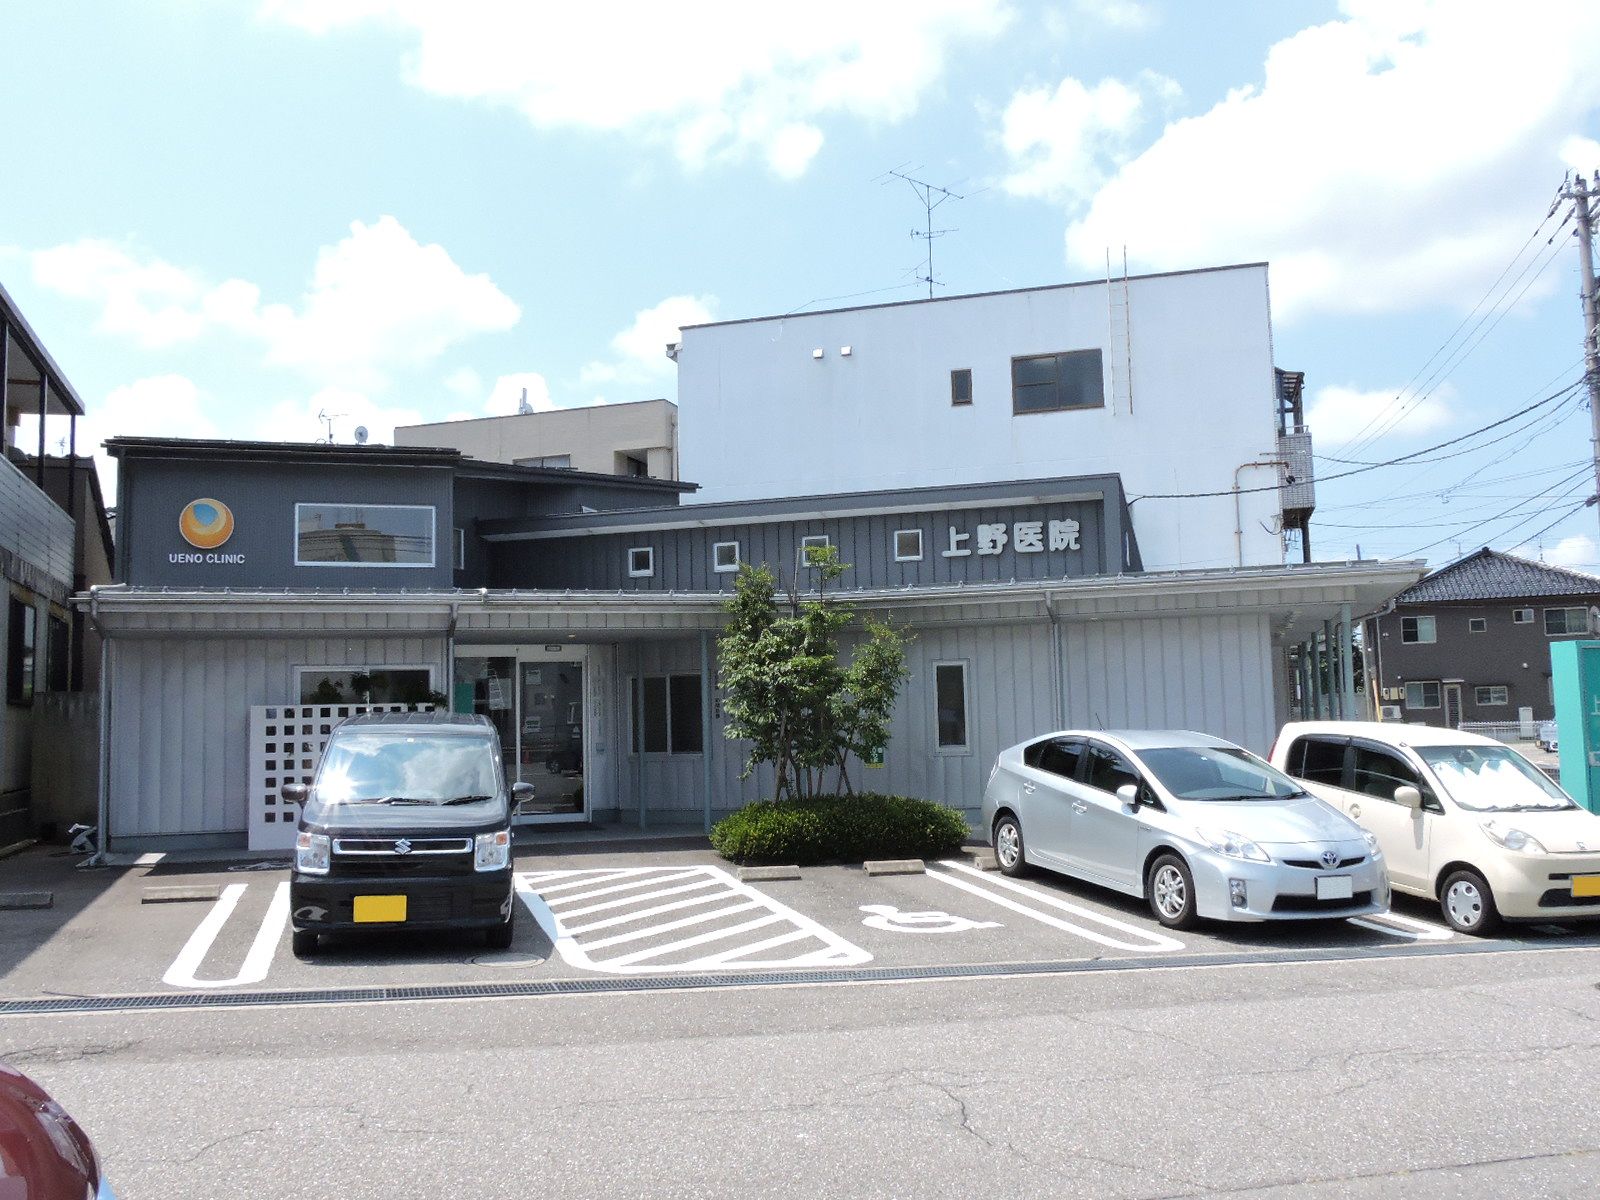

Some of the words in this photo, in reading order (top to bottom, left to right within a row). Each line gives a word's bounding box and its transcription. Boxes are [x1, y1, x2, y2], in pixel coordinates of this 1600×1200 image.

[941, 519, 1081, 558] 上野医院
[168, 553, 203, 564] UENO
[206, 554, 246, 564] CLINIC
